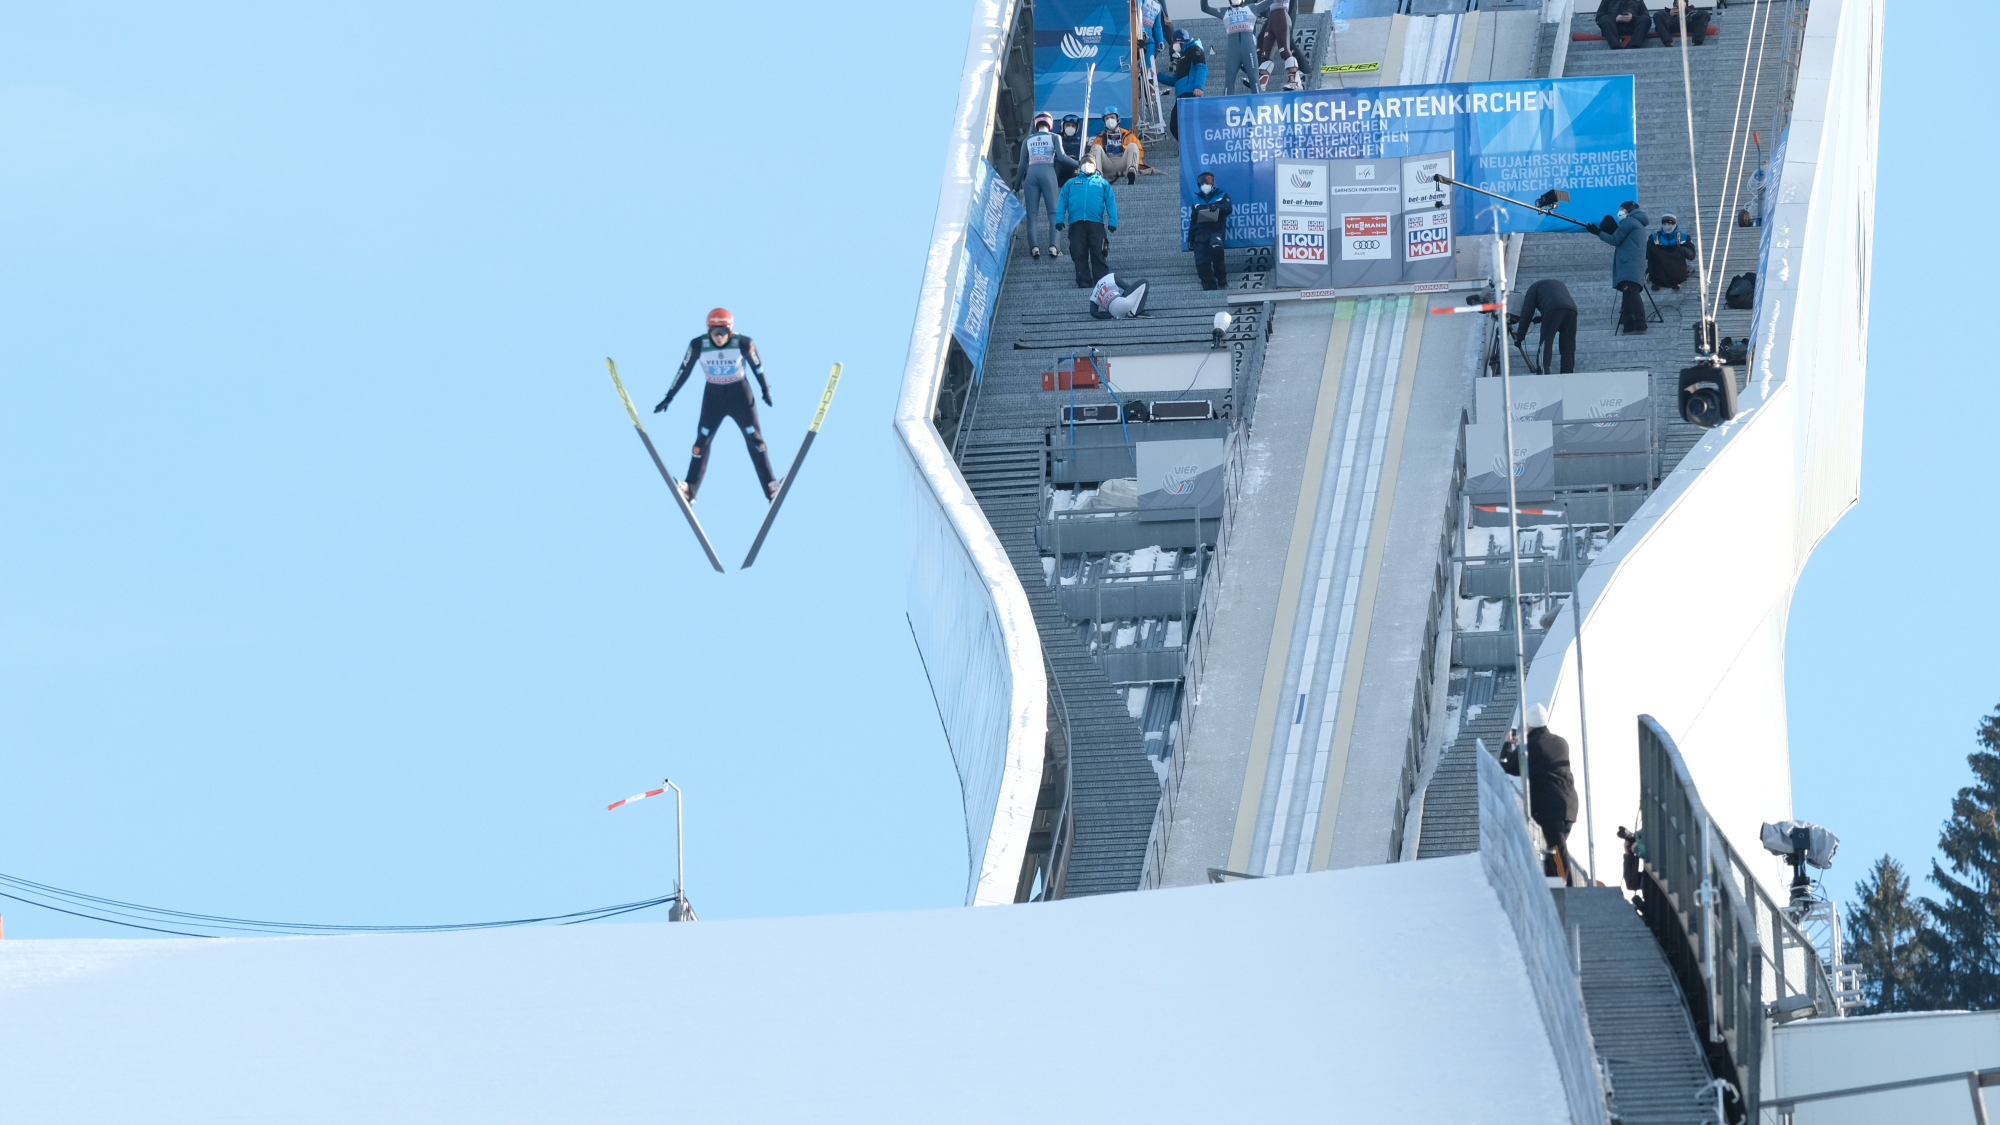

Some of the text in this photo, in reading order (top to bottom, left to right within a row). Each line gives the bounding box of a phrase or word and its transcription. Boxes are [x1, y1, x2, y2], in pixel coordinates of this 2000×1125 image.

[1074, 25, 1104, 36] VIER
[1321, 62, 1378, 73] FISCHER
[1225, 90, 1555, 127] GARMISCH-PARTENKIRCHEN
[1204, 118, 1389, 141] GARMISCH-PARTENKIRCHEN
[1224, 130, 1409, 152] GARMISCH-PARTENKIRCHEN
[1033, 147, 1045, 155] 38
[1200, 143, 1385, 166] GARMISCH-PARTENKIRCHEN
[1479, 149, 1637, 169] NEUJAHRSSKISPRINGEN
[1282, 198, 1324, 206] bet-at-home
[1408, 193, 1447, 203] bet-at-home
[1284, 234, 1323, 247] LIQUI
[1410, 227, 1447, 244] LIQUI
[1284, 247, 1324, 260] MOLY
[1410, 241, 1448, 257] MOLY
[712, 366, 731, 375] 37
[809, 362, 842, 433] FISCHER
[1600, 399, 1623, 407] VIER
[1513, 402, 1537, 411] VIER
[1174, 465, 1198, 475] VIER
